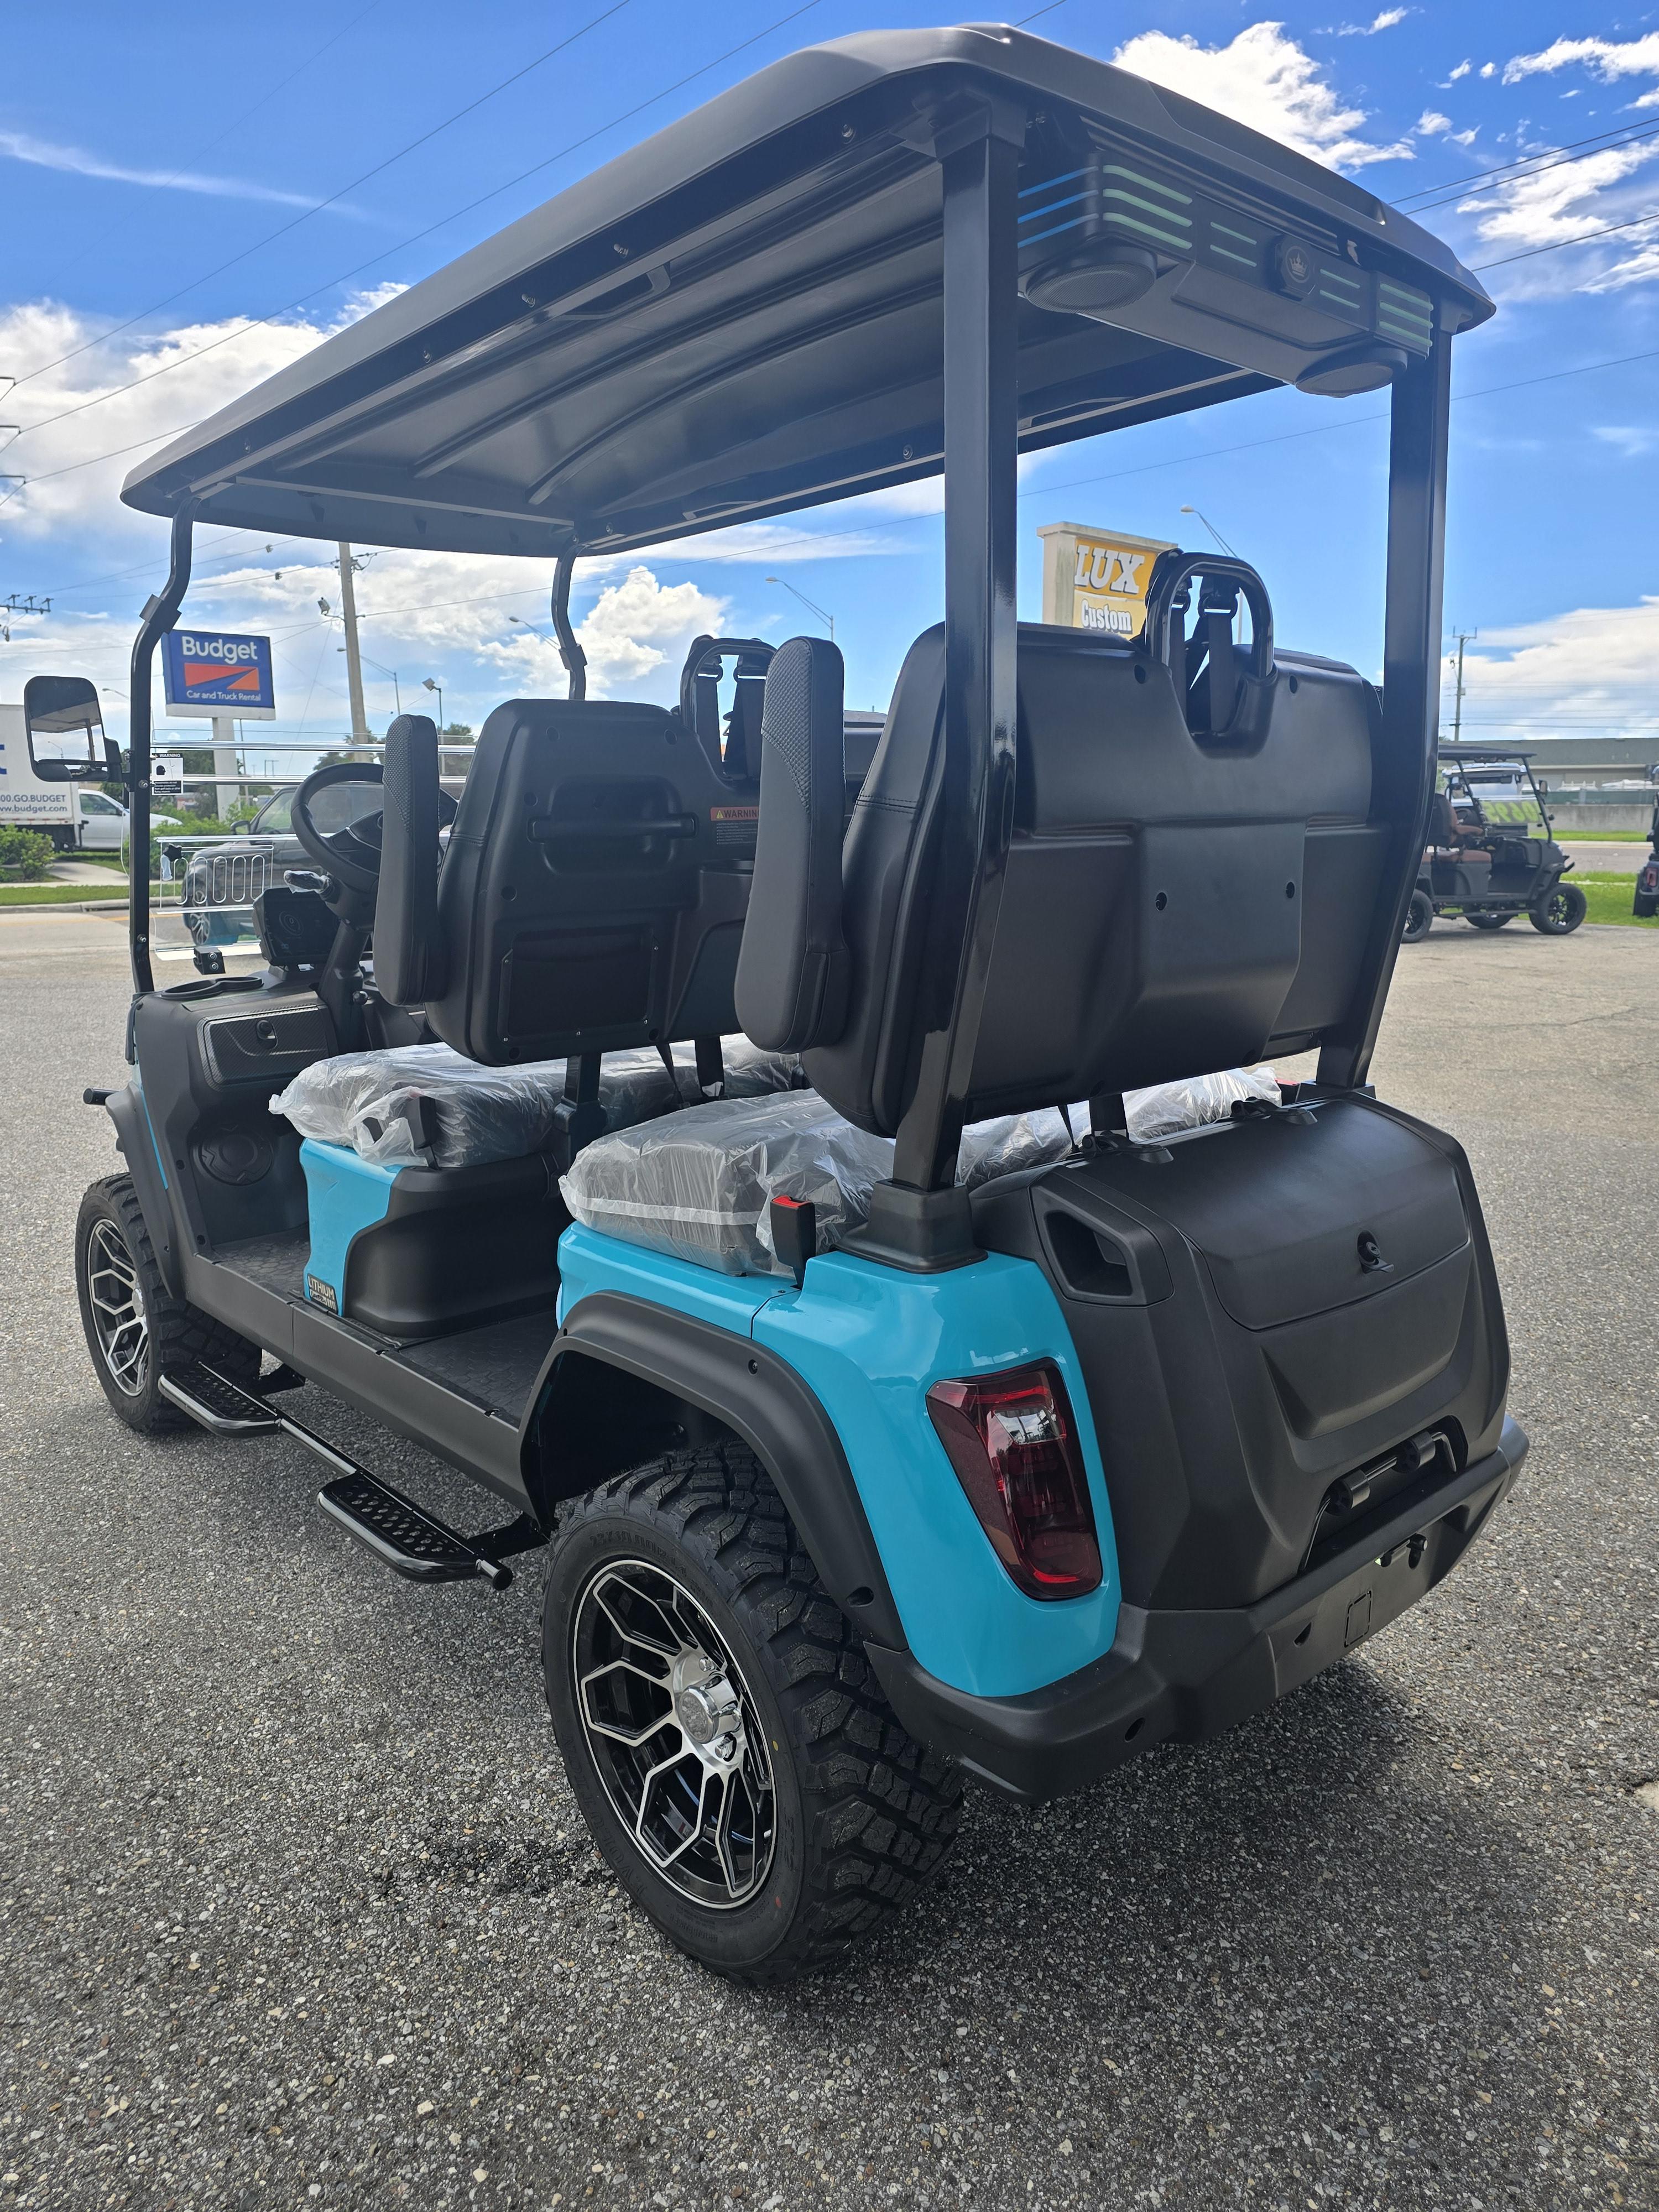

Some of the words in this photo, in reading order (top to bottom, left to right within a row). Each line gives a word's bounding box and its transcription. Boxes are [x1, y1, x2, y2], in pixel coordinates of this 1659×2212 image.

[1074, 545, 1145, 594] LUX
[1081, 599, 1132, 634] Custom
[181, 636, 258, 664] Budget
[186, 690, 200, 698] Car
[201, 691, 216, 700] and
[217, 692, 238, 700] Truck
[724, 809, 759, 818] WARNIN
[308, 1275, 335, 1300] LITHIUM
